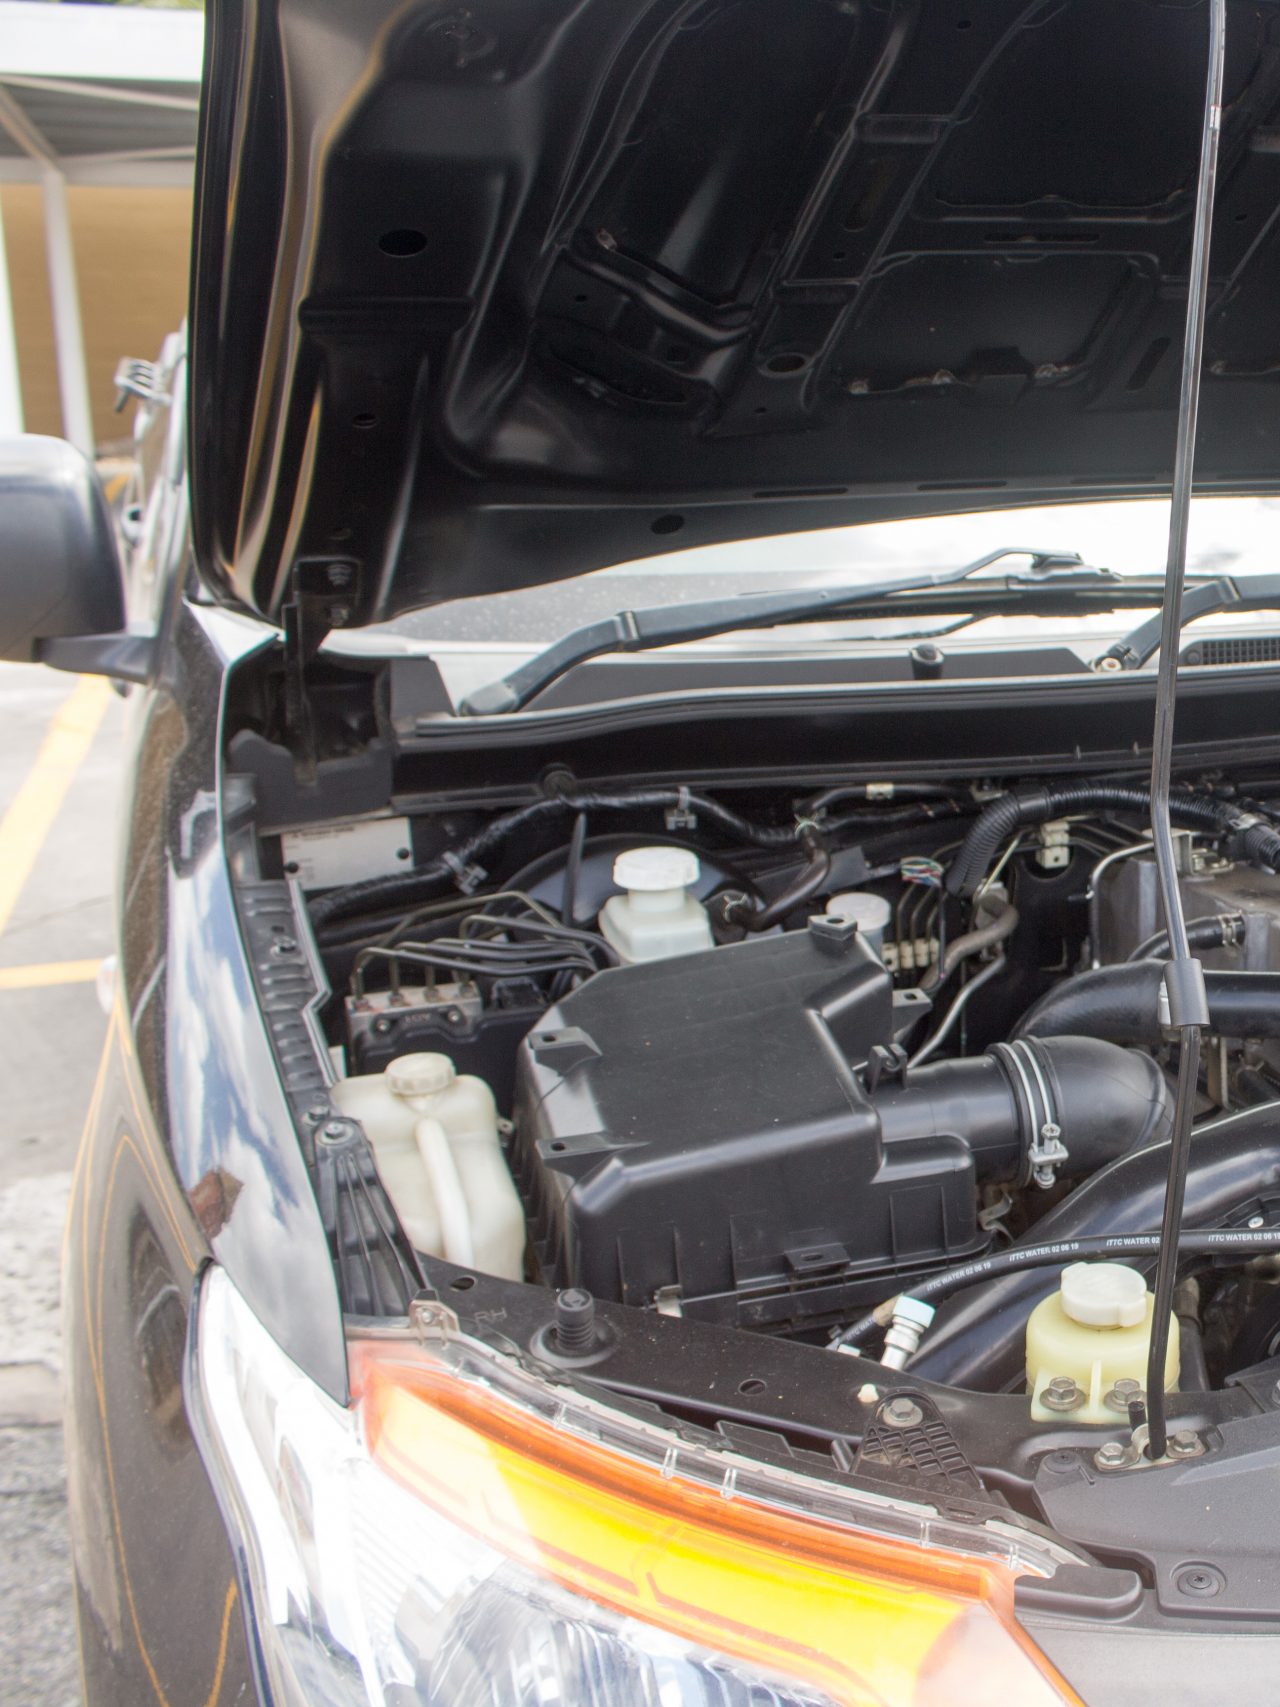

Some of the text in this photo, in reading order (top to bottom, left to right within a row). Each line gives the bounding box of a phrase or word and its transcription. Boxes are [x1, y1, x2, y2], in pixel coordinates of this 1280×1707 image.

[1106, 1238, 1123, 1247] ITTC
[1123, 1236, 1151, 1246] WATER
[1208, 1233, 1224, 1242] ITTC
[1225, 1233, 1253, 1241] WATER
[1009, 1251, 1025, 1262] ITTC
[1025, 1246, 1051, 1259] WATER
[942, 1270, 965, 1285] WATER
